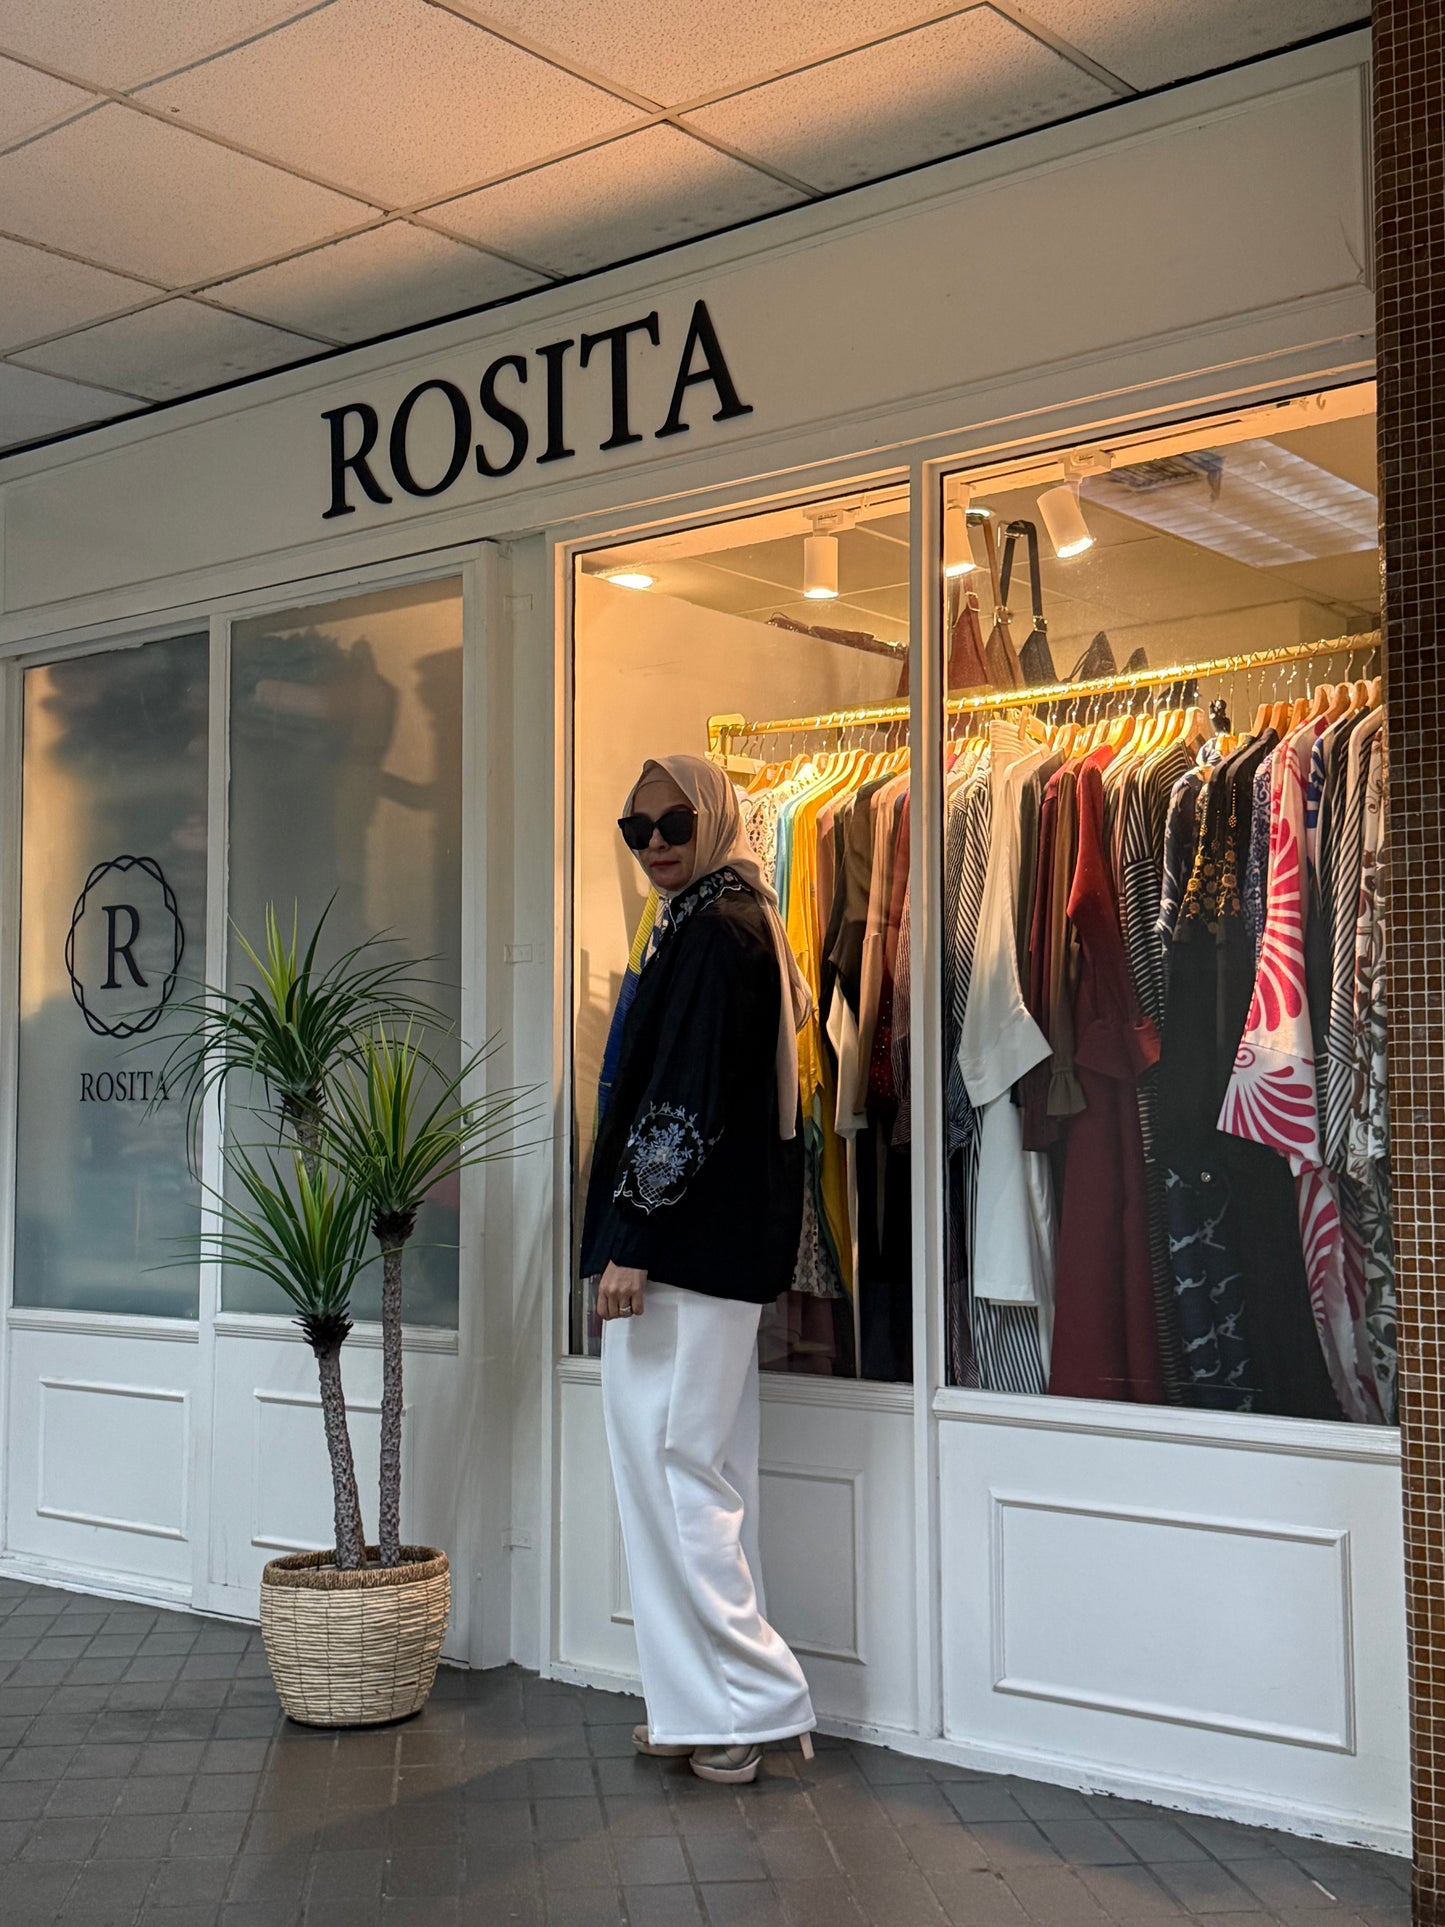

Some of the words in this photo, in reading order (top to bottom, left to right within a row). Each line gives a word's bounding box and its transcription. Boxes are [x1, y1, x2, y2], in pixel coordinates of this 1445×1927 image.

[321, 299, 753, 519] ROSITA
[100, 904, 148, 989] R
[80, 1071, 170, 1102] ROSITA
